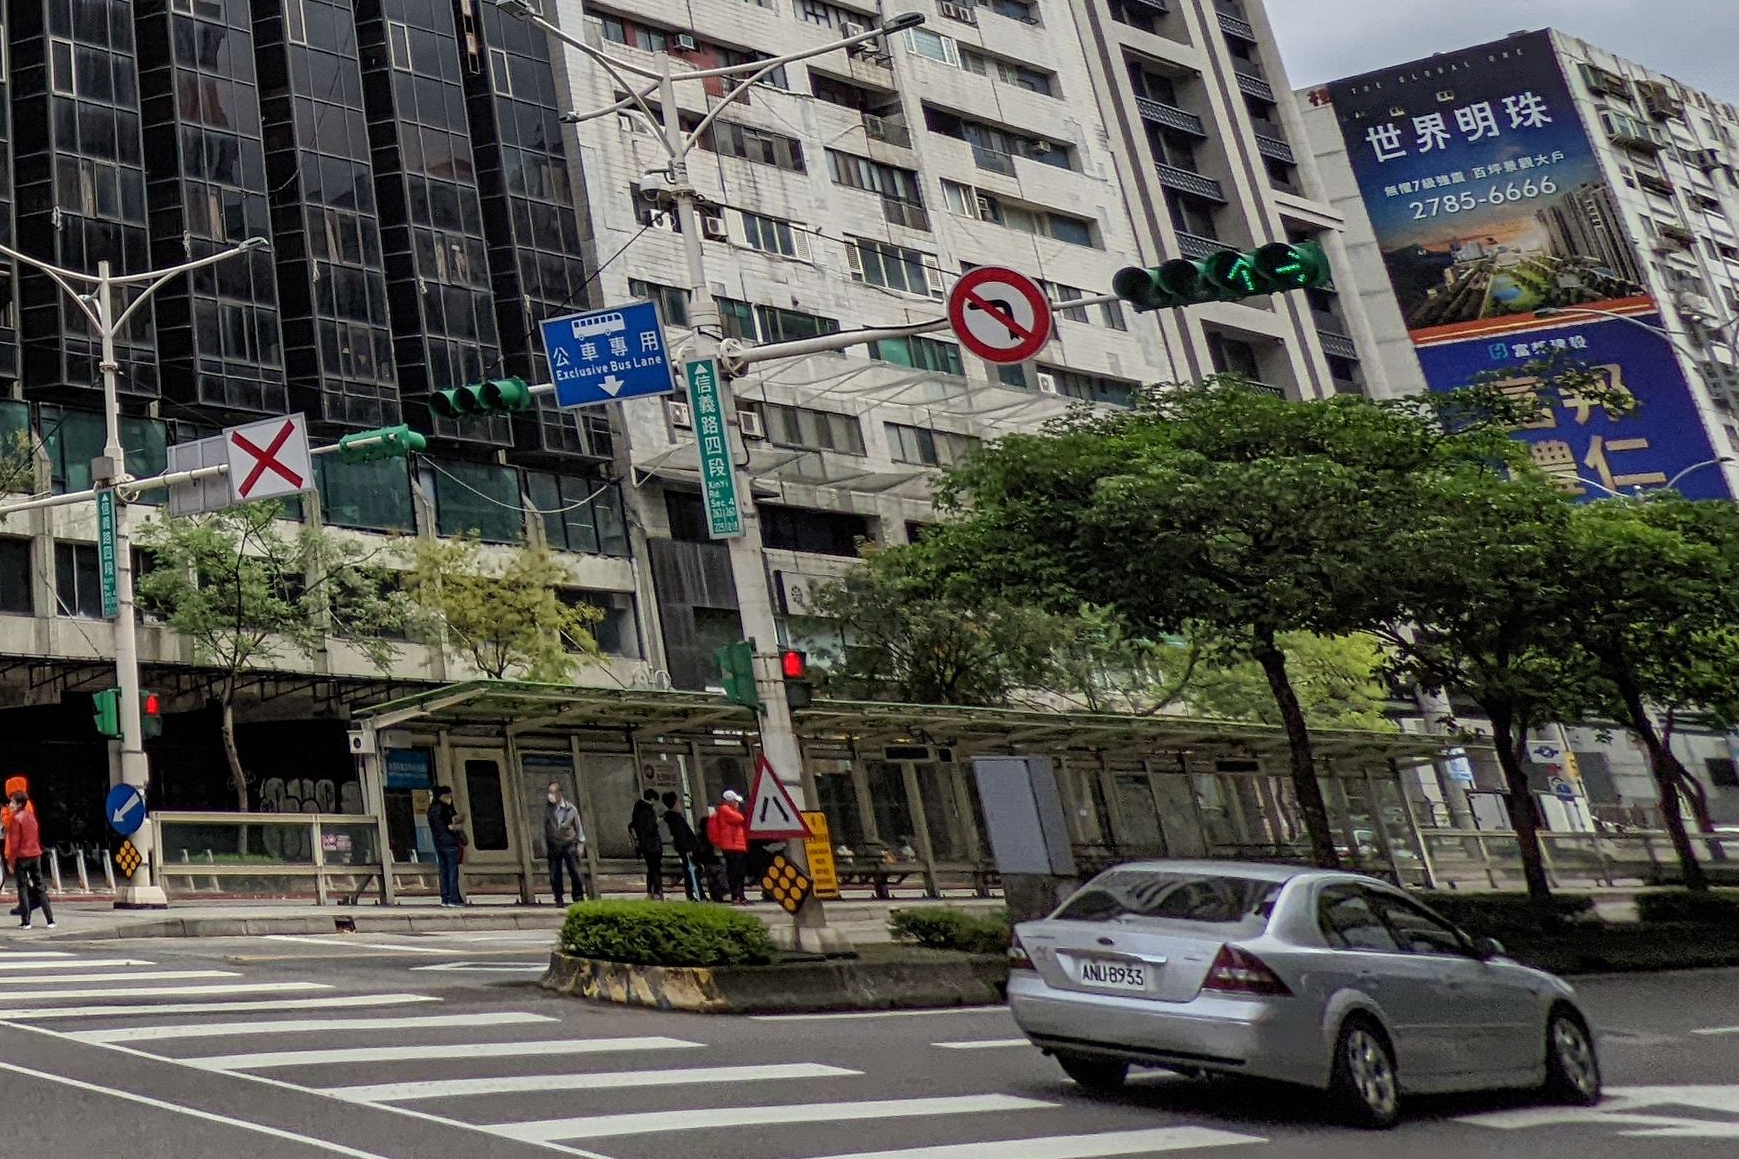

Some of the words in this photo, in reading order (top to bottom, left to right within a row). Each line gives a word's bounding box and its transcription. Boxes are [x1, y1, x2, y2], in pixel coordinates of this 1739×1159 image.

[1364, 91, 1553, 163] 世界明珠
[1409, 174, 1559, 221] 2785-6666
[553, 330, 659, 367] 公車專用
[556, 362, 608, 381] Exclusive
[610, 358, 632, 372] Bus
[633, 355, 662, 368] Lane
[695, 375, 726, 478] 信義路四段
